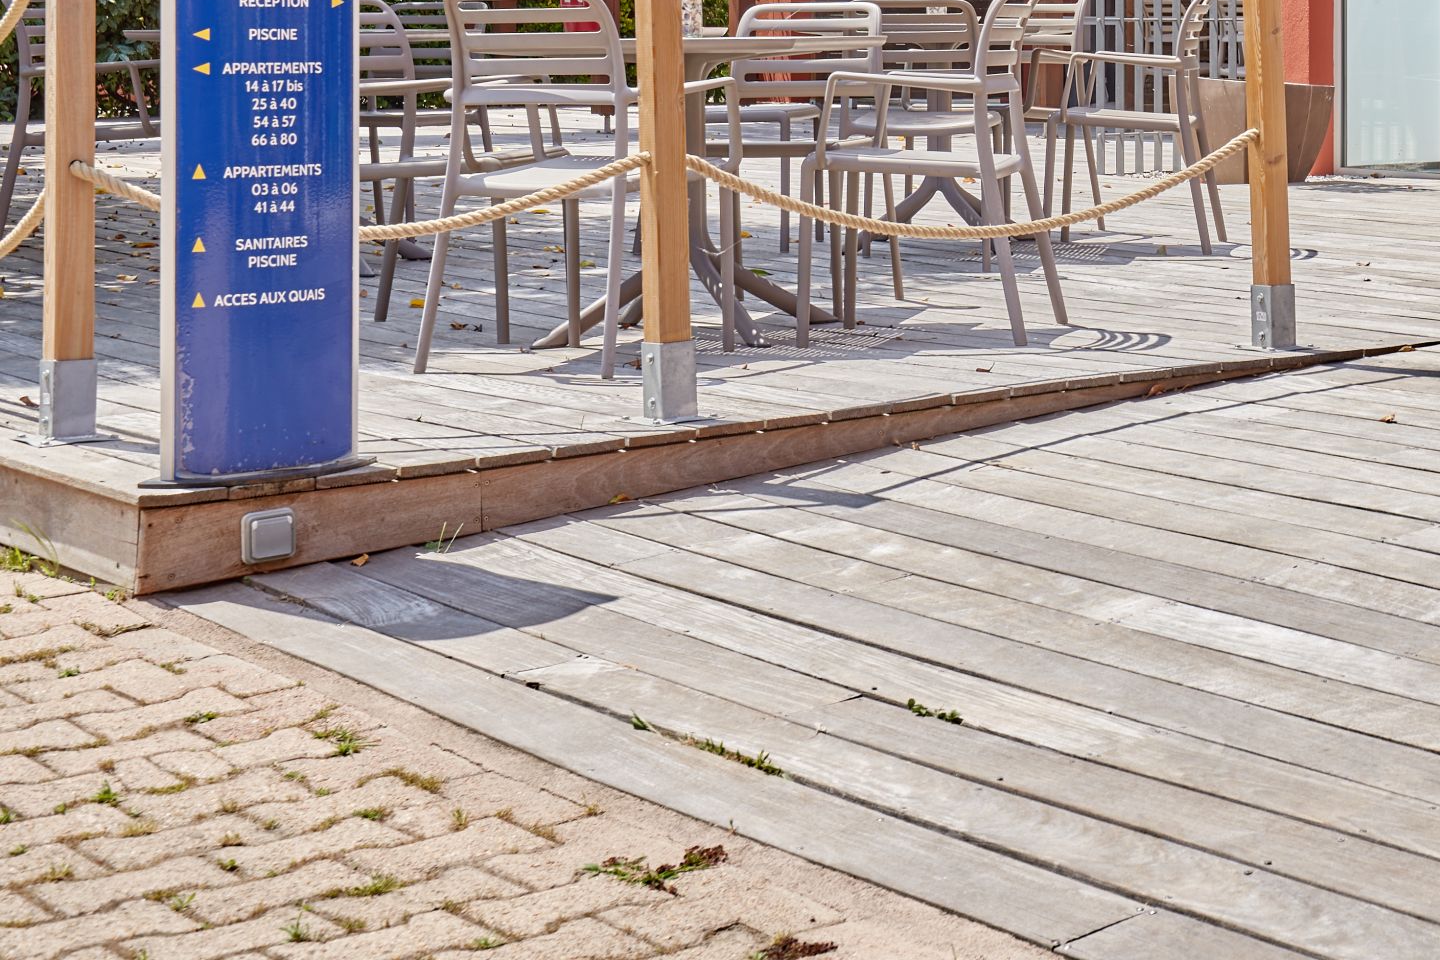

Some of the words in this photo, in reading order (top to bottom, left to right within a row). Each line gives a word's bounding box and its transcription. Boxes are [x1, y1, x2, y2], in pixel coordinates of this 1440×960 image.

[248, 28, 298, 41] PISCINE
[222, 62, 323, 75] APPARTEMENTS
[245, 80, 259, 92] 14
[261, 79, 270, 92] à
[271, 80, 284, 92] 17
[286, 79, 303, 92] bis
[252, 98, 267, 110] 25
[269, 97, 277, 110] à
[279, 98, 297, 110] 40
[253, 115, 269, 128] 54
[271, 115, 279, 127] à
[281, 115, 296, 127] 57
[251, 134, 267, 146] 66
[269, 133, 278, 146] à
[280, 133, 297, 145] 80
[223, 163, 322, 179] APPARTEMENTS
[251, 183, 269, 196] 03
[271, 183, 279, 195] à
[281, 182, 298, 195] 06
[254, 201, 267, 213] 41
[269, 200, 277, 213] à
[279, 200, 295, 212] 44
[235, 236, 308, 251] SANITAIRES
[248, 254, 297, 268] PISCINE
[214, 293, 257, 307] ACCES
[259, 291, 286, 304] AUX
[288, 288, 325, 304] QUAIS
